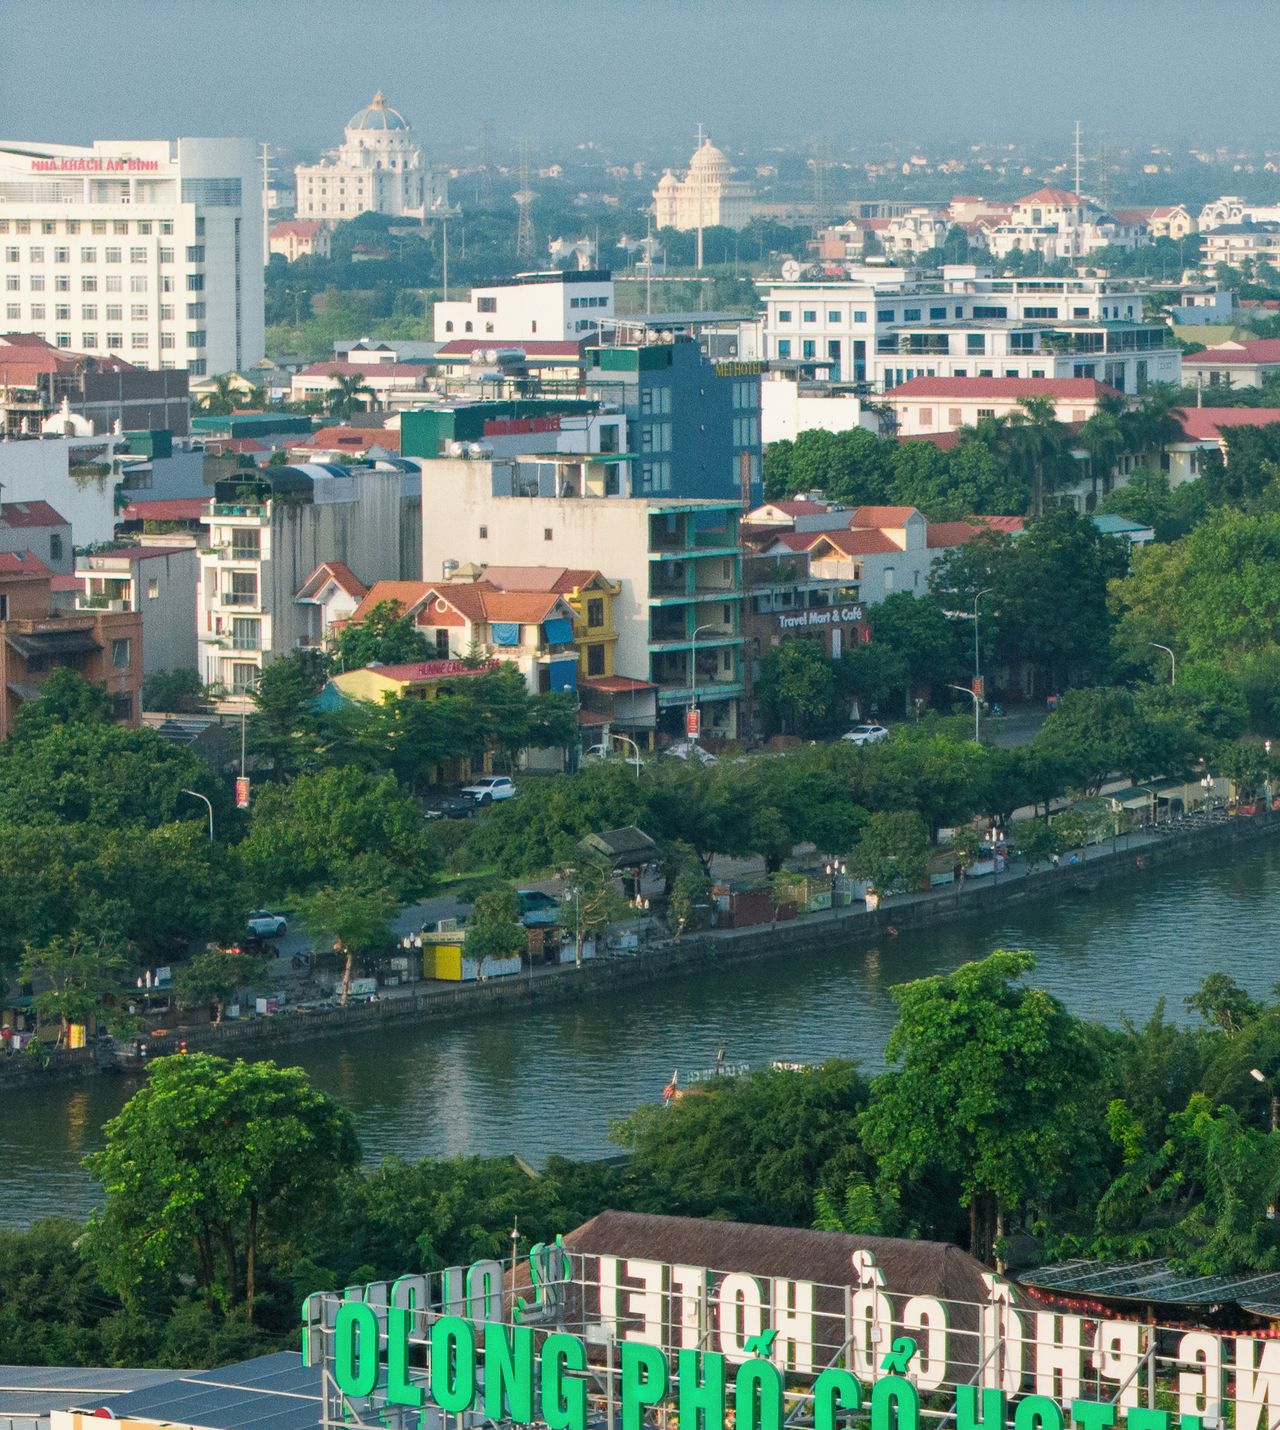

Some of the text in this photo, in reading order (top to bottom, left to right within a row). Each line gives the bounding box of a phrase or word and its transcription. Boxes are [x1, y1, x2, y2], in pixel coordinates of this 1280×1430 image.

[779, 606, 862, 628] Travel Mart & Café
